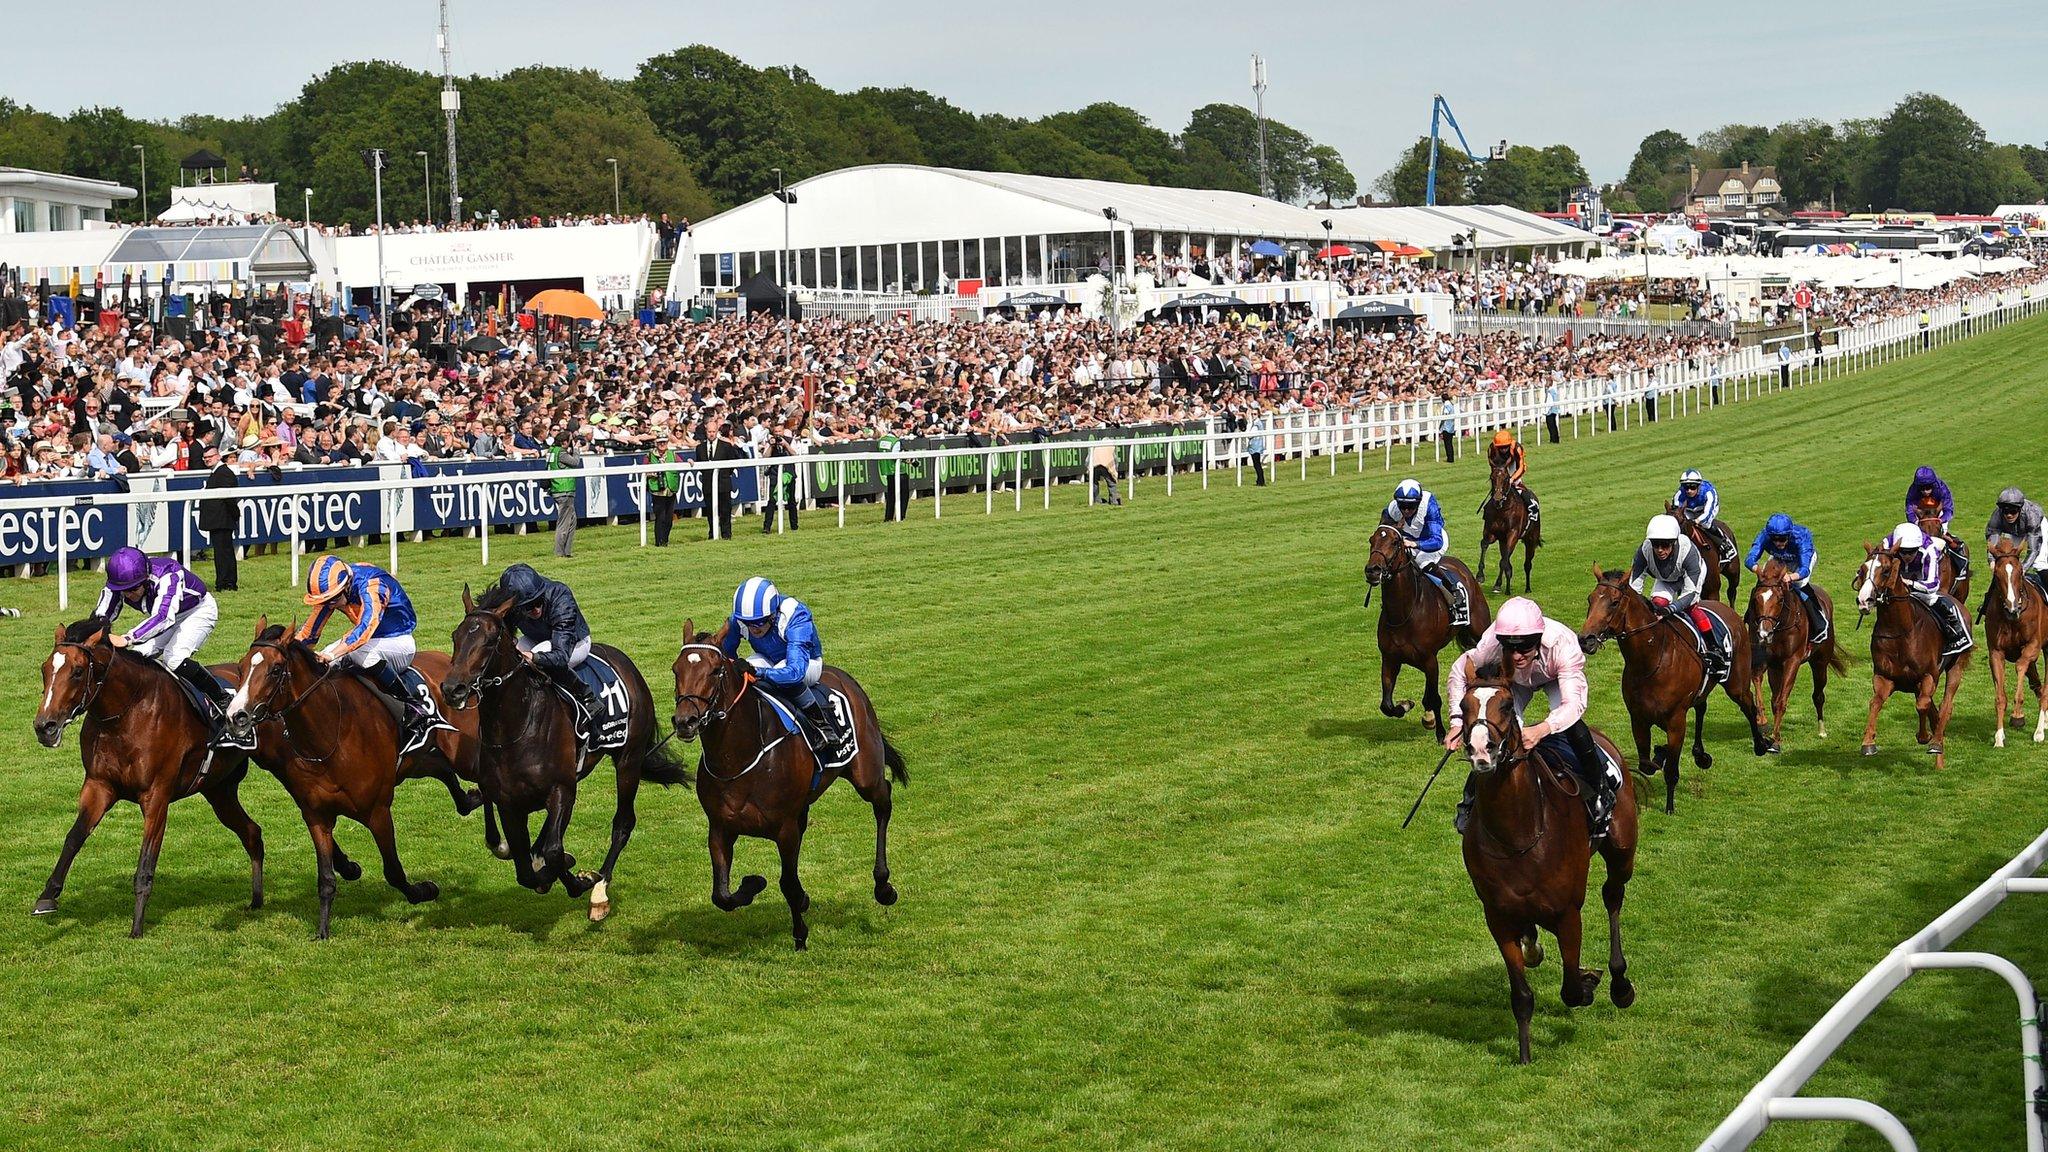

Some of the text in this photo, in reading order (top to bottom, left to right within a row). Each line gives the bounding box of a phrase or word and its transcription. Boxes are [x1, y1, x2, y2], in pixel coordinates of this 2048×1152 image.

[1180, 298, 1214, 306] TRACKSIDE
[457, 470, 560, 521] Investe
[0, 507, 104, 557] estec
[416, 684, 435, 715] 3
[600, 680, 628, 717] 11
